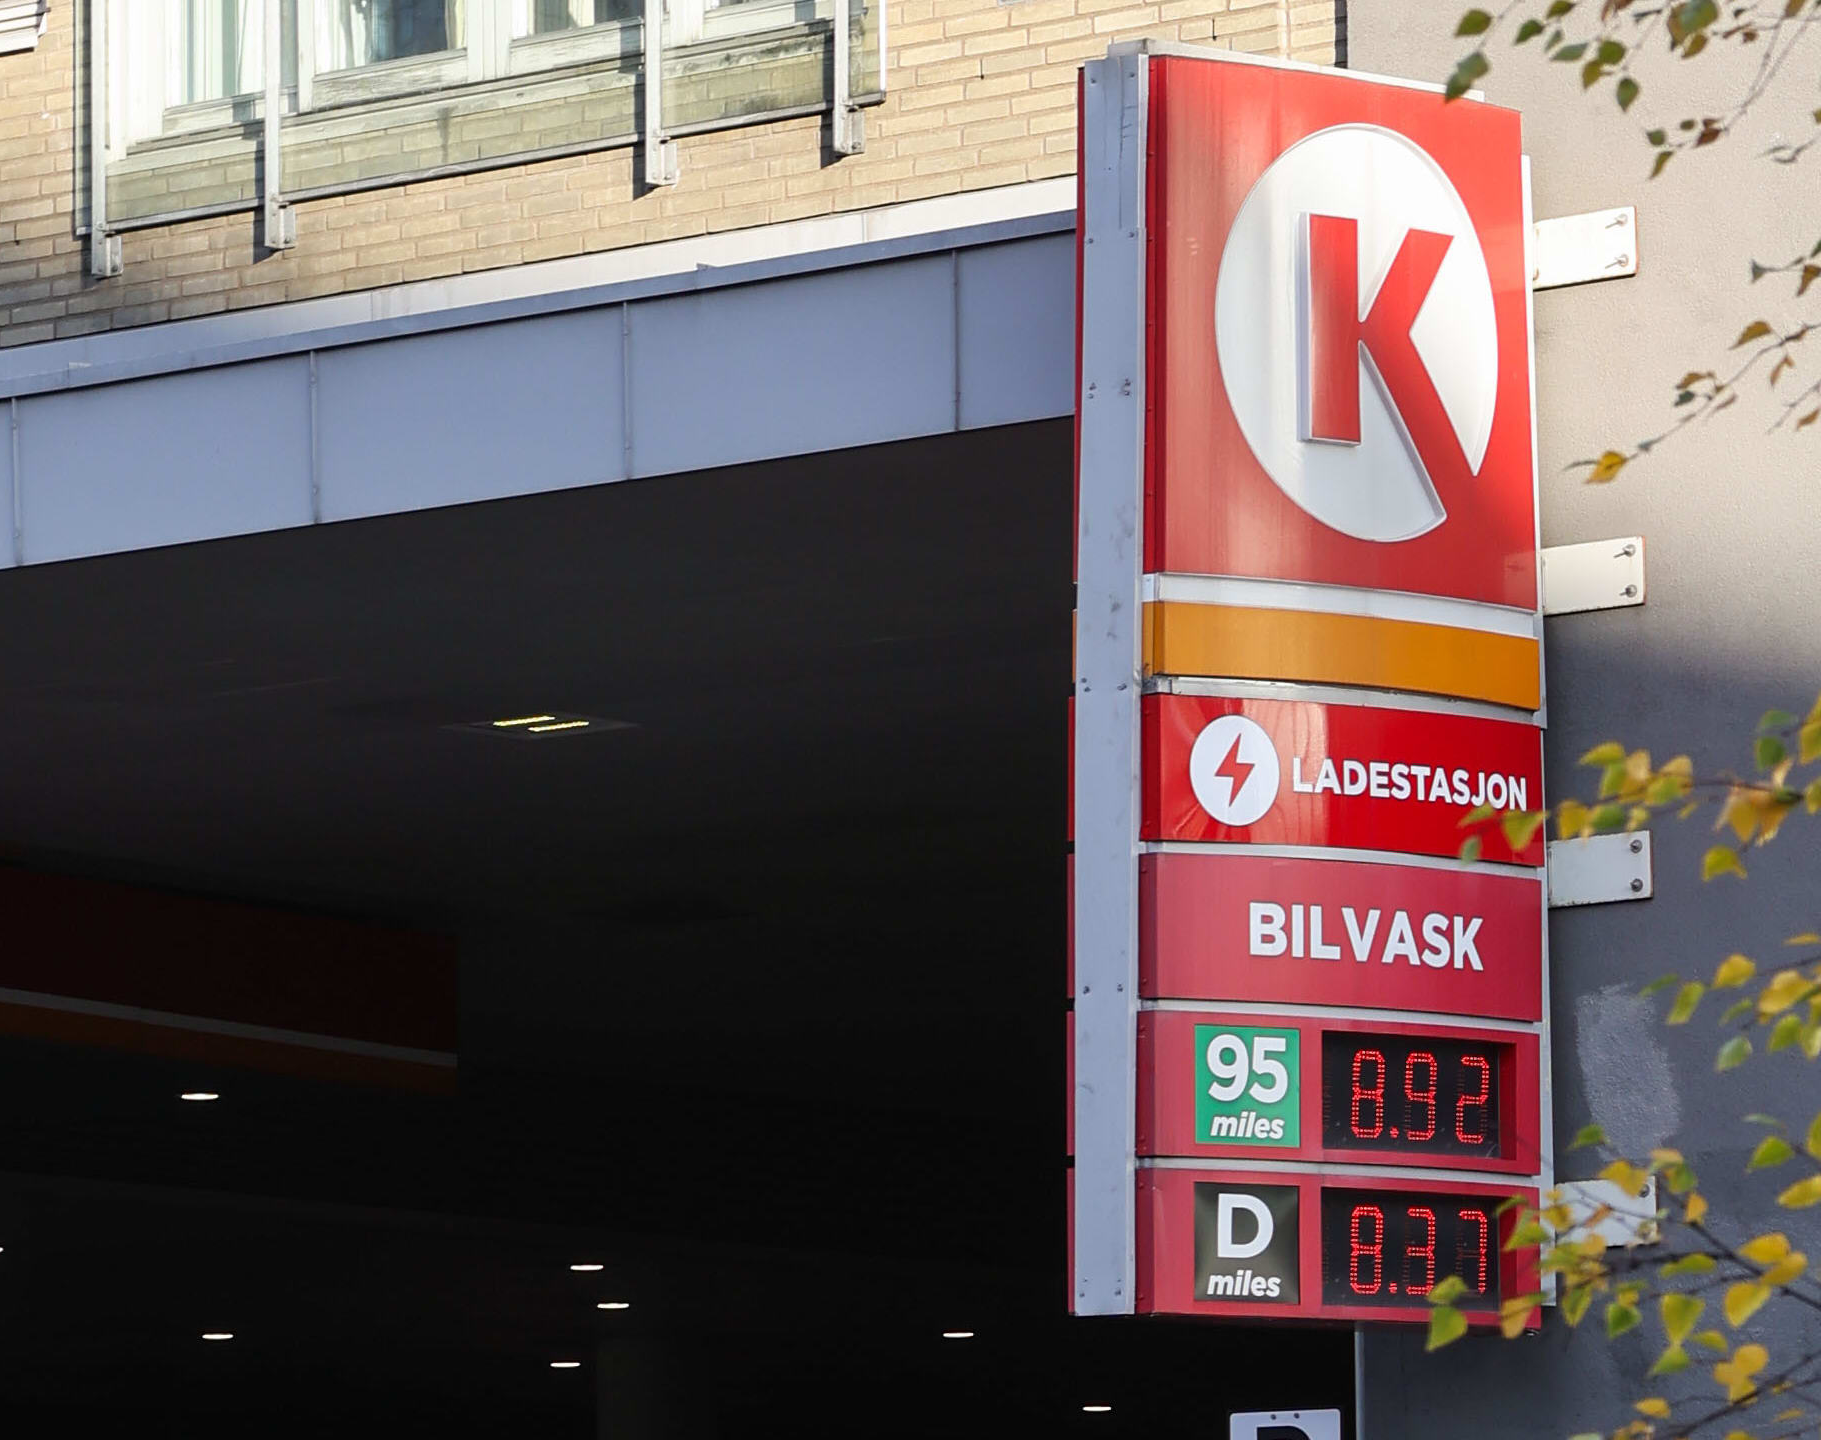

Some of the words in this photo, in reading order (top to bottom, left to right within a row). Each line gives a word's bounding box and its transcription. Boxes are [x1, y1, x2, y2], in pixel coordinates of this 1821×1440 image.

[1292, 757, 1529, 812] LADESTASJON
[1248, 901, 1485, 972] BILVASK
[1204, 1033, 1289, 1104] 95
[1349, 1049, 1491, 1145] 8.92
[1209, 1111, 1286, 1141] miles
[1216, 1193, 1275, 1260] D
[1348, 1205, 1489, 1297] 8.37
[1206, 1270, 1283, 1299] miles
